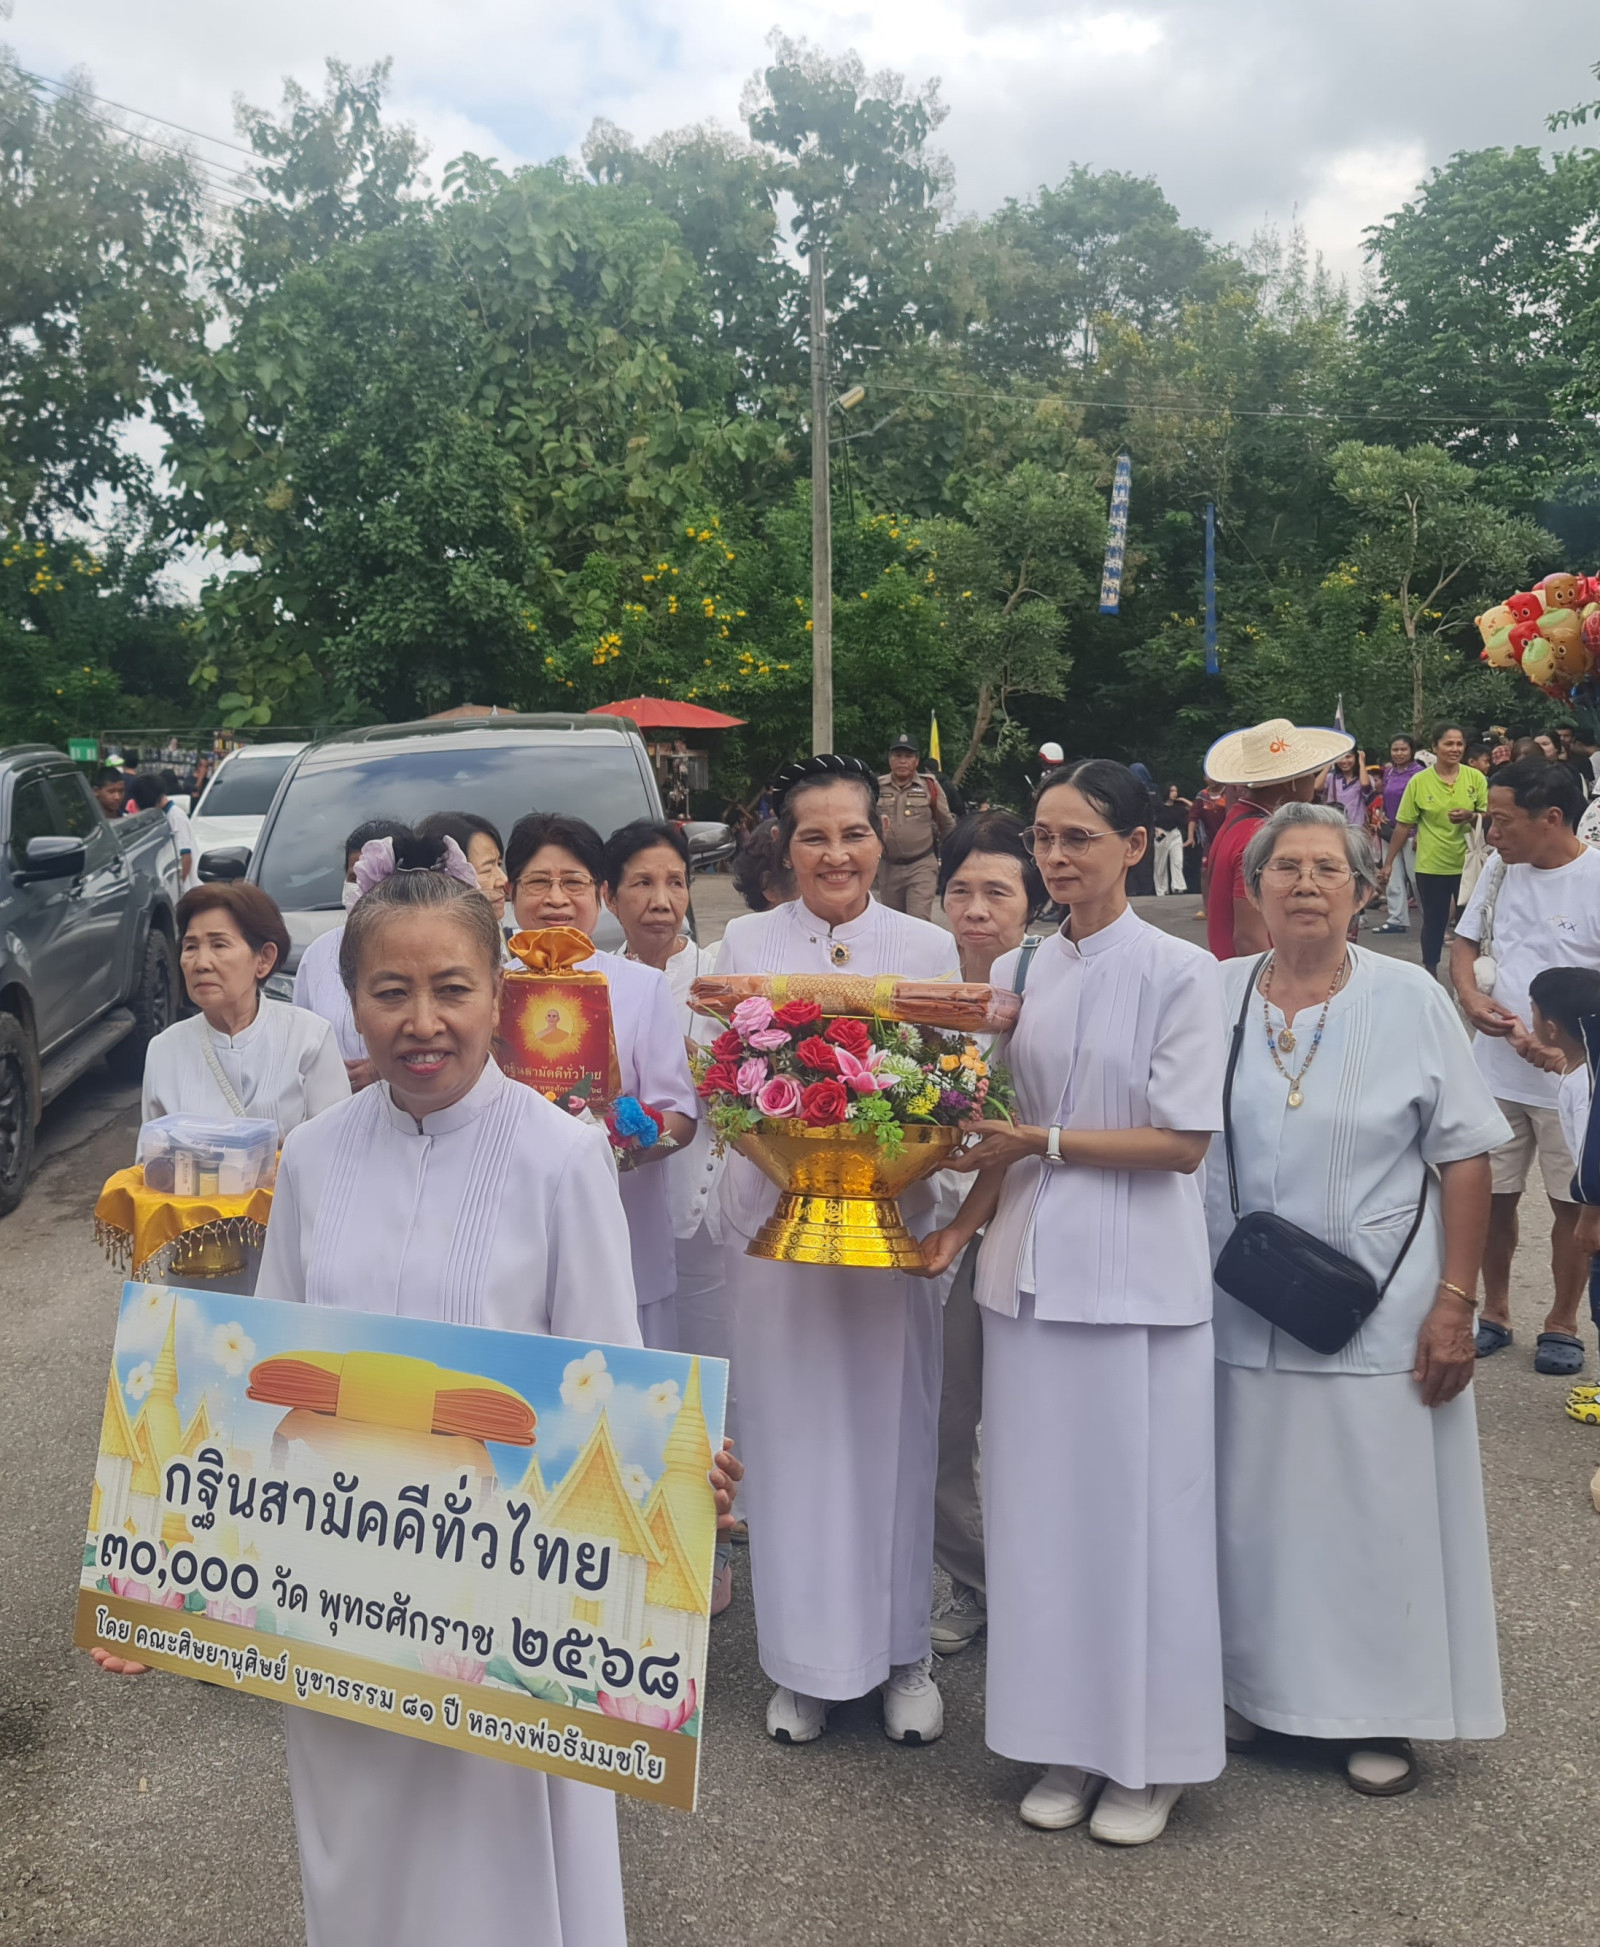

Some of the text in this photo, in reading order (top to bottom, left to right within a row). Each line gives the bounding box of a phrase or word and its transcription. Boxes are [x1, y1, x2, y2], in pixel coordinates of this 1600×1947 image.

[165, 1447, 611, 1591] กฐินสามัคคีทั่วไทย
[97, 1609, 663, 1780] โดย คณะศิษยานุศิษย์ บูชาธรรม ๘๑ ปี หลวงพ่อธัมมชโย
[100, 1532, 681, 1700] ๓๐,๐๐๐ วัด พุทธศักราช ๒๕๖๘
